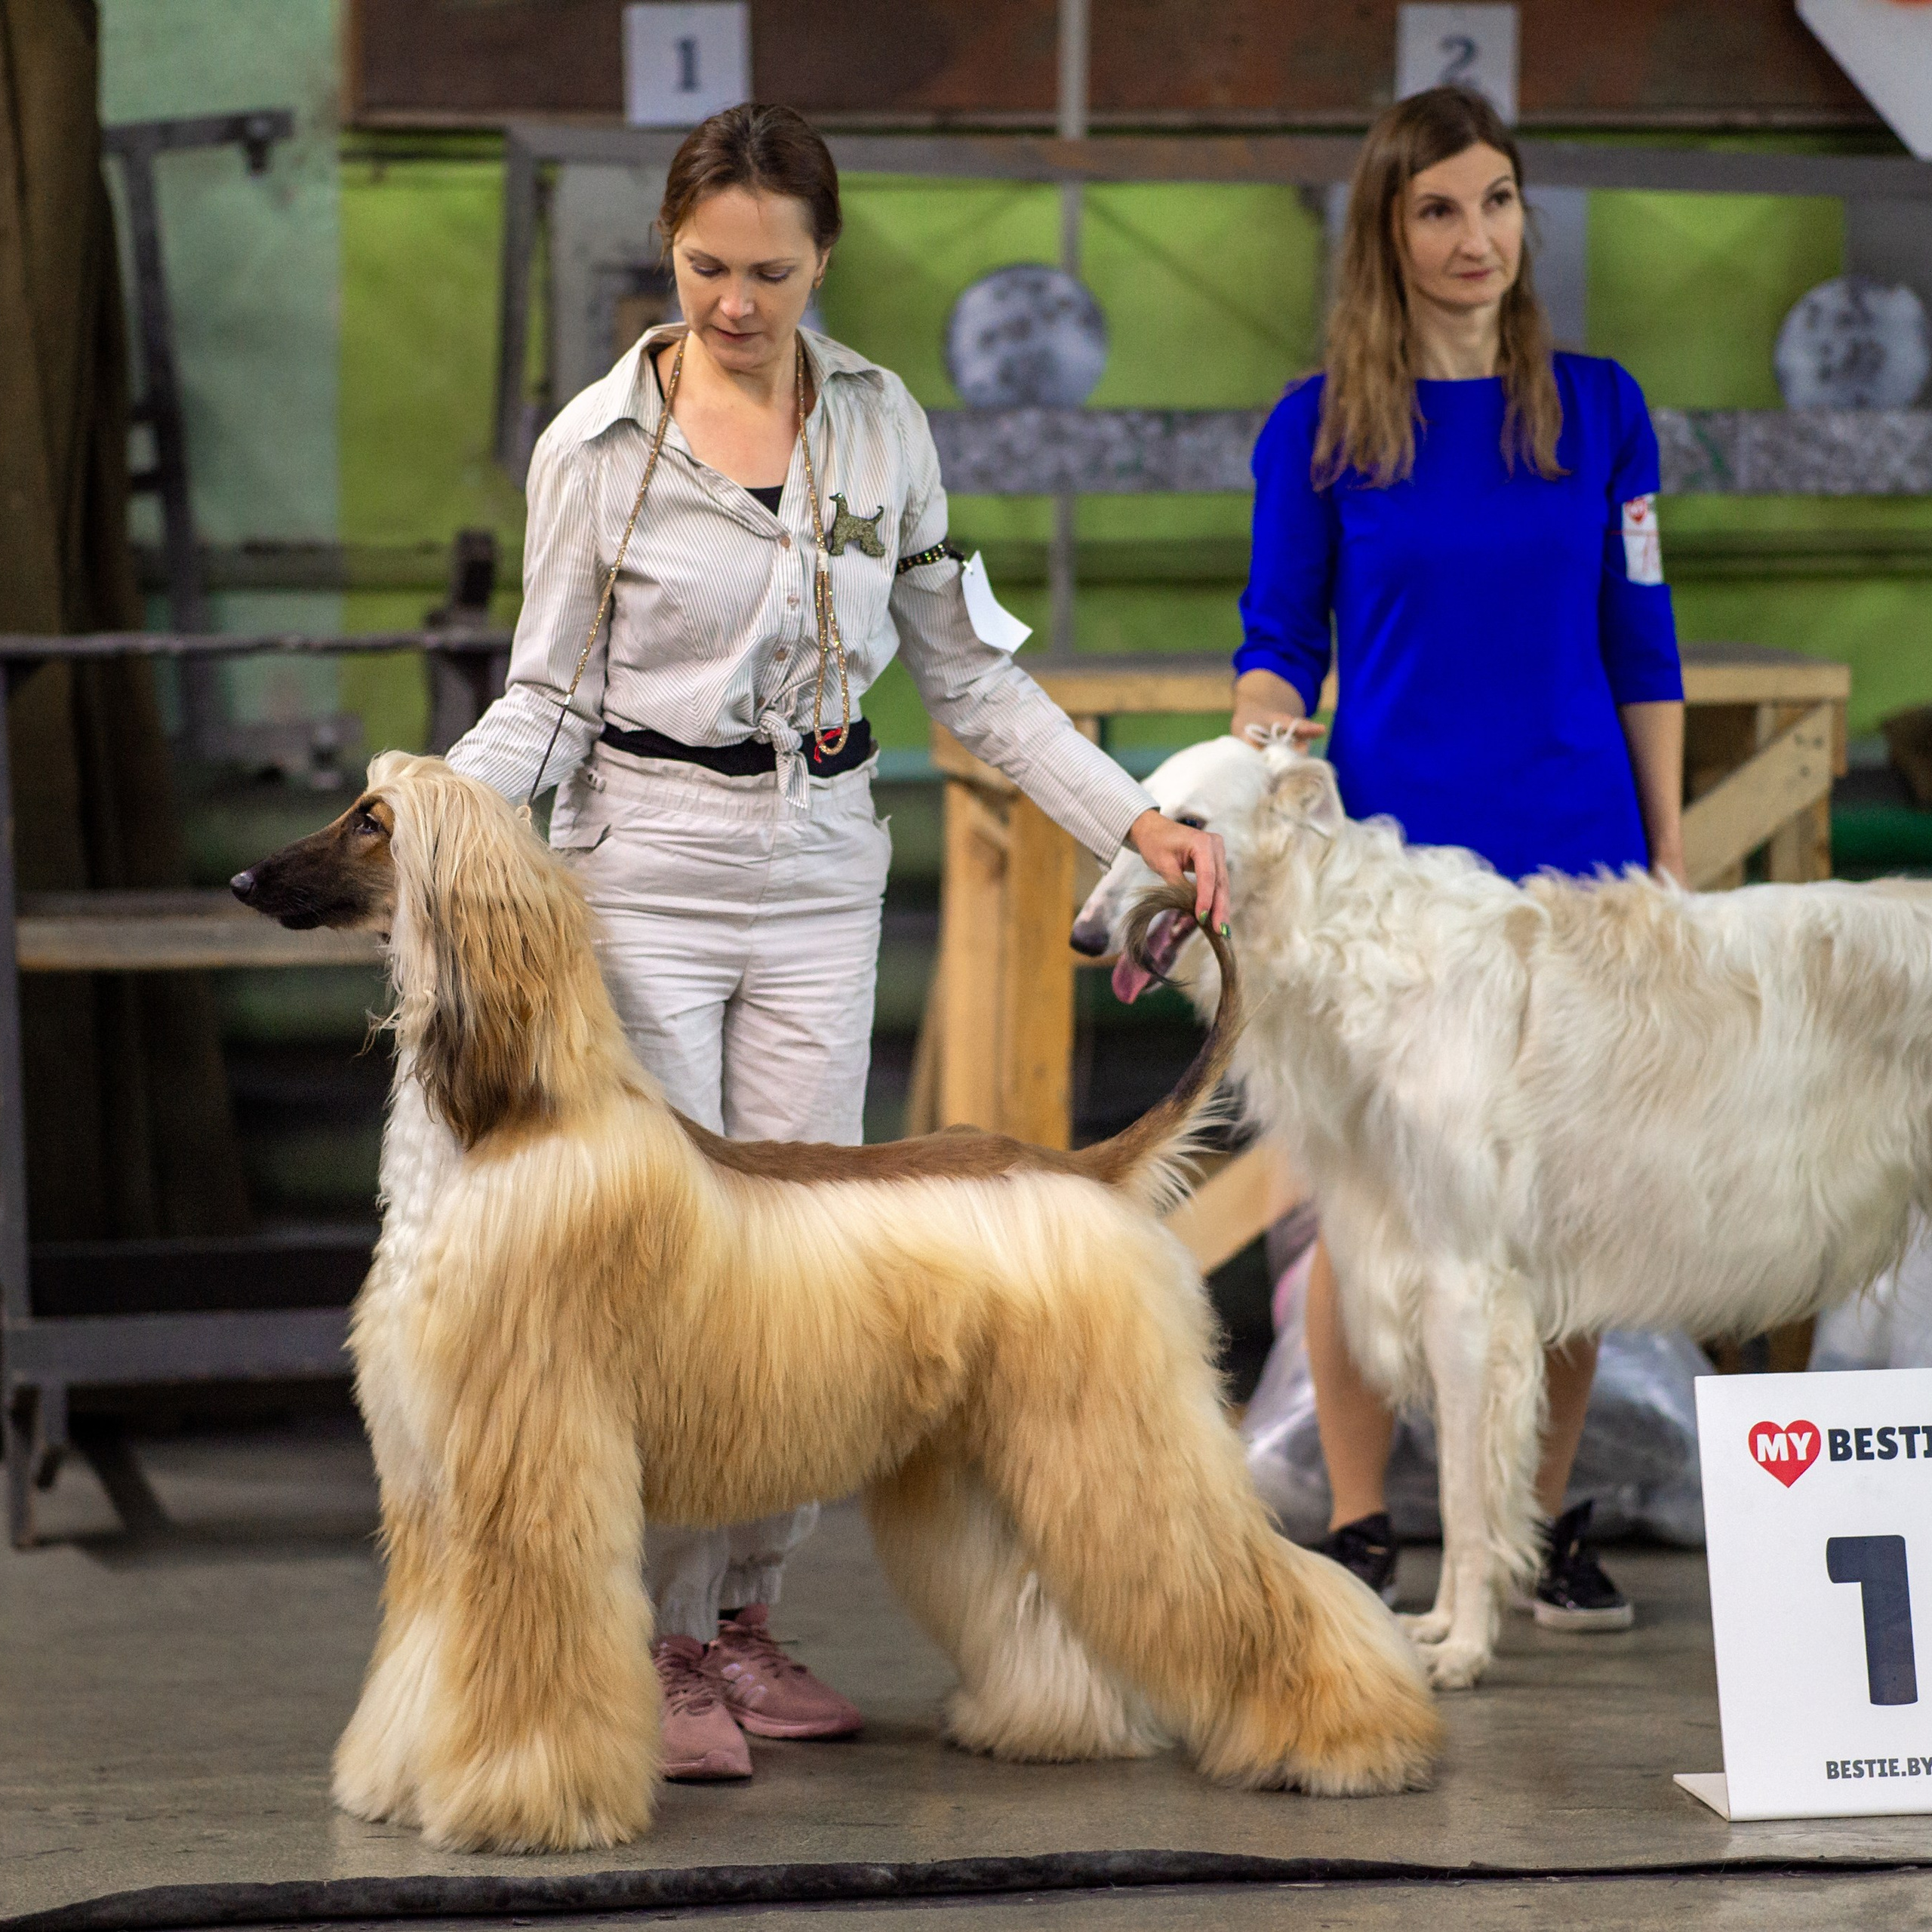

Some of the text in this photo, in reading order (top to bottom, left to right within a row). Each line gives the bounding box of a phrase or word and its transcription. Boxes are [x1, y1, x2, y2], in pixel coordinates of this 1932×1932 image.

[674, 36, 701, 94] 1
[1439, 35, 1478, 88] 2
[1756, 1432, 1813, 1463] MY
[1826, 1535, 1918, 1706] 1
[1826, 1757, 1932, 1780] BESTIE.BY
